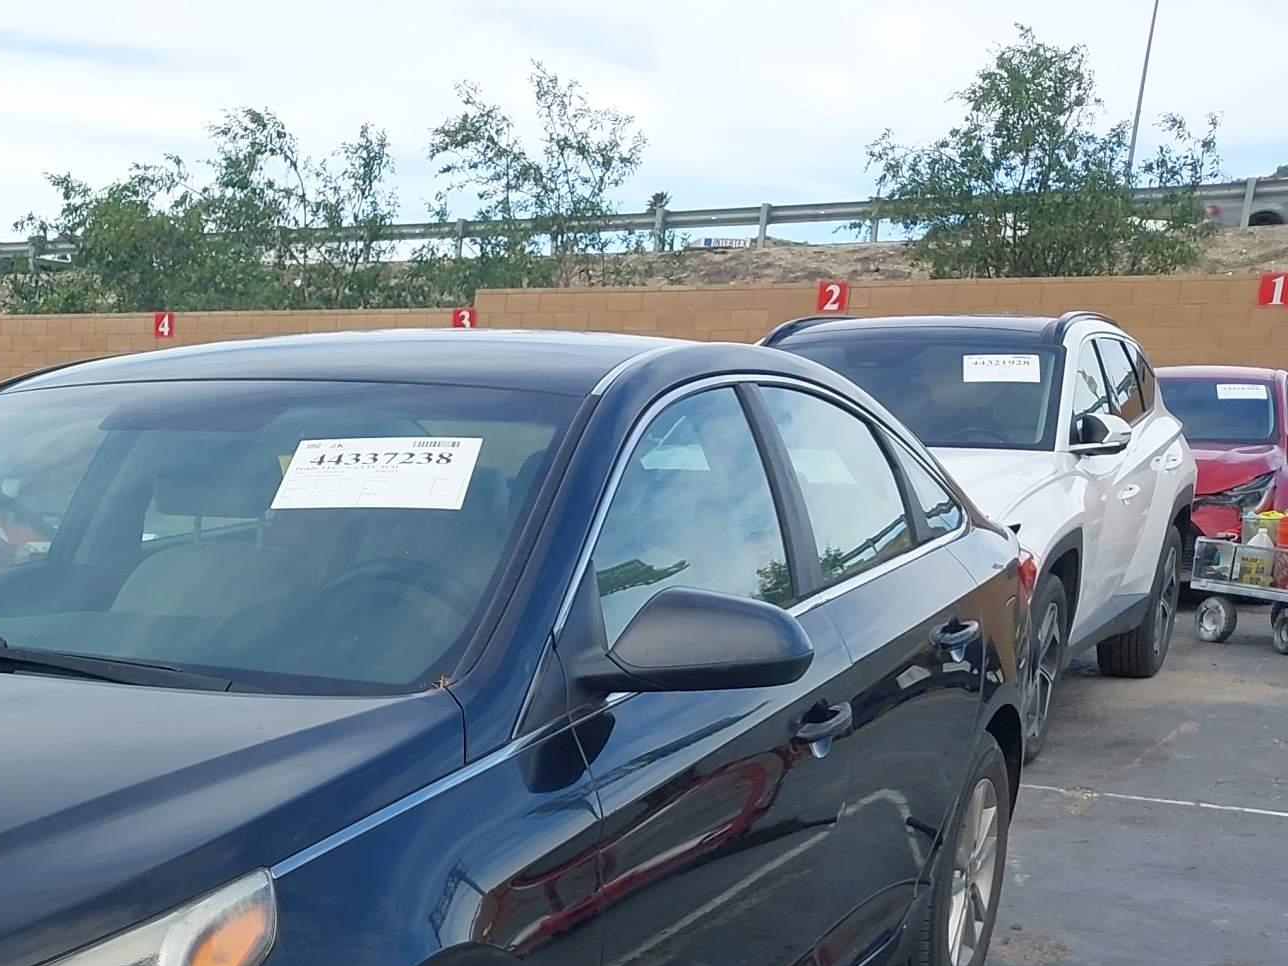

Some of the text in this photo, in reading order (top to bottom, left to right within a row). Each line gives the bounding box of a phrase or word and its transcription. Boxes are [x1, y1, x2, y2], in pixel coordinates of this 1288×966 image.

[823, 284, 840, 310] 2
[1267, 276, 1285, 305] 1
[158, 313, 170, 336] 4
[458, 310, 471, 328] 3
[309, 452, 454, 466] 44337238
